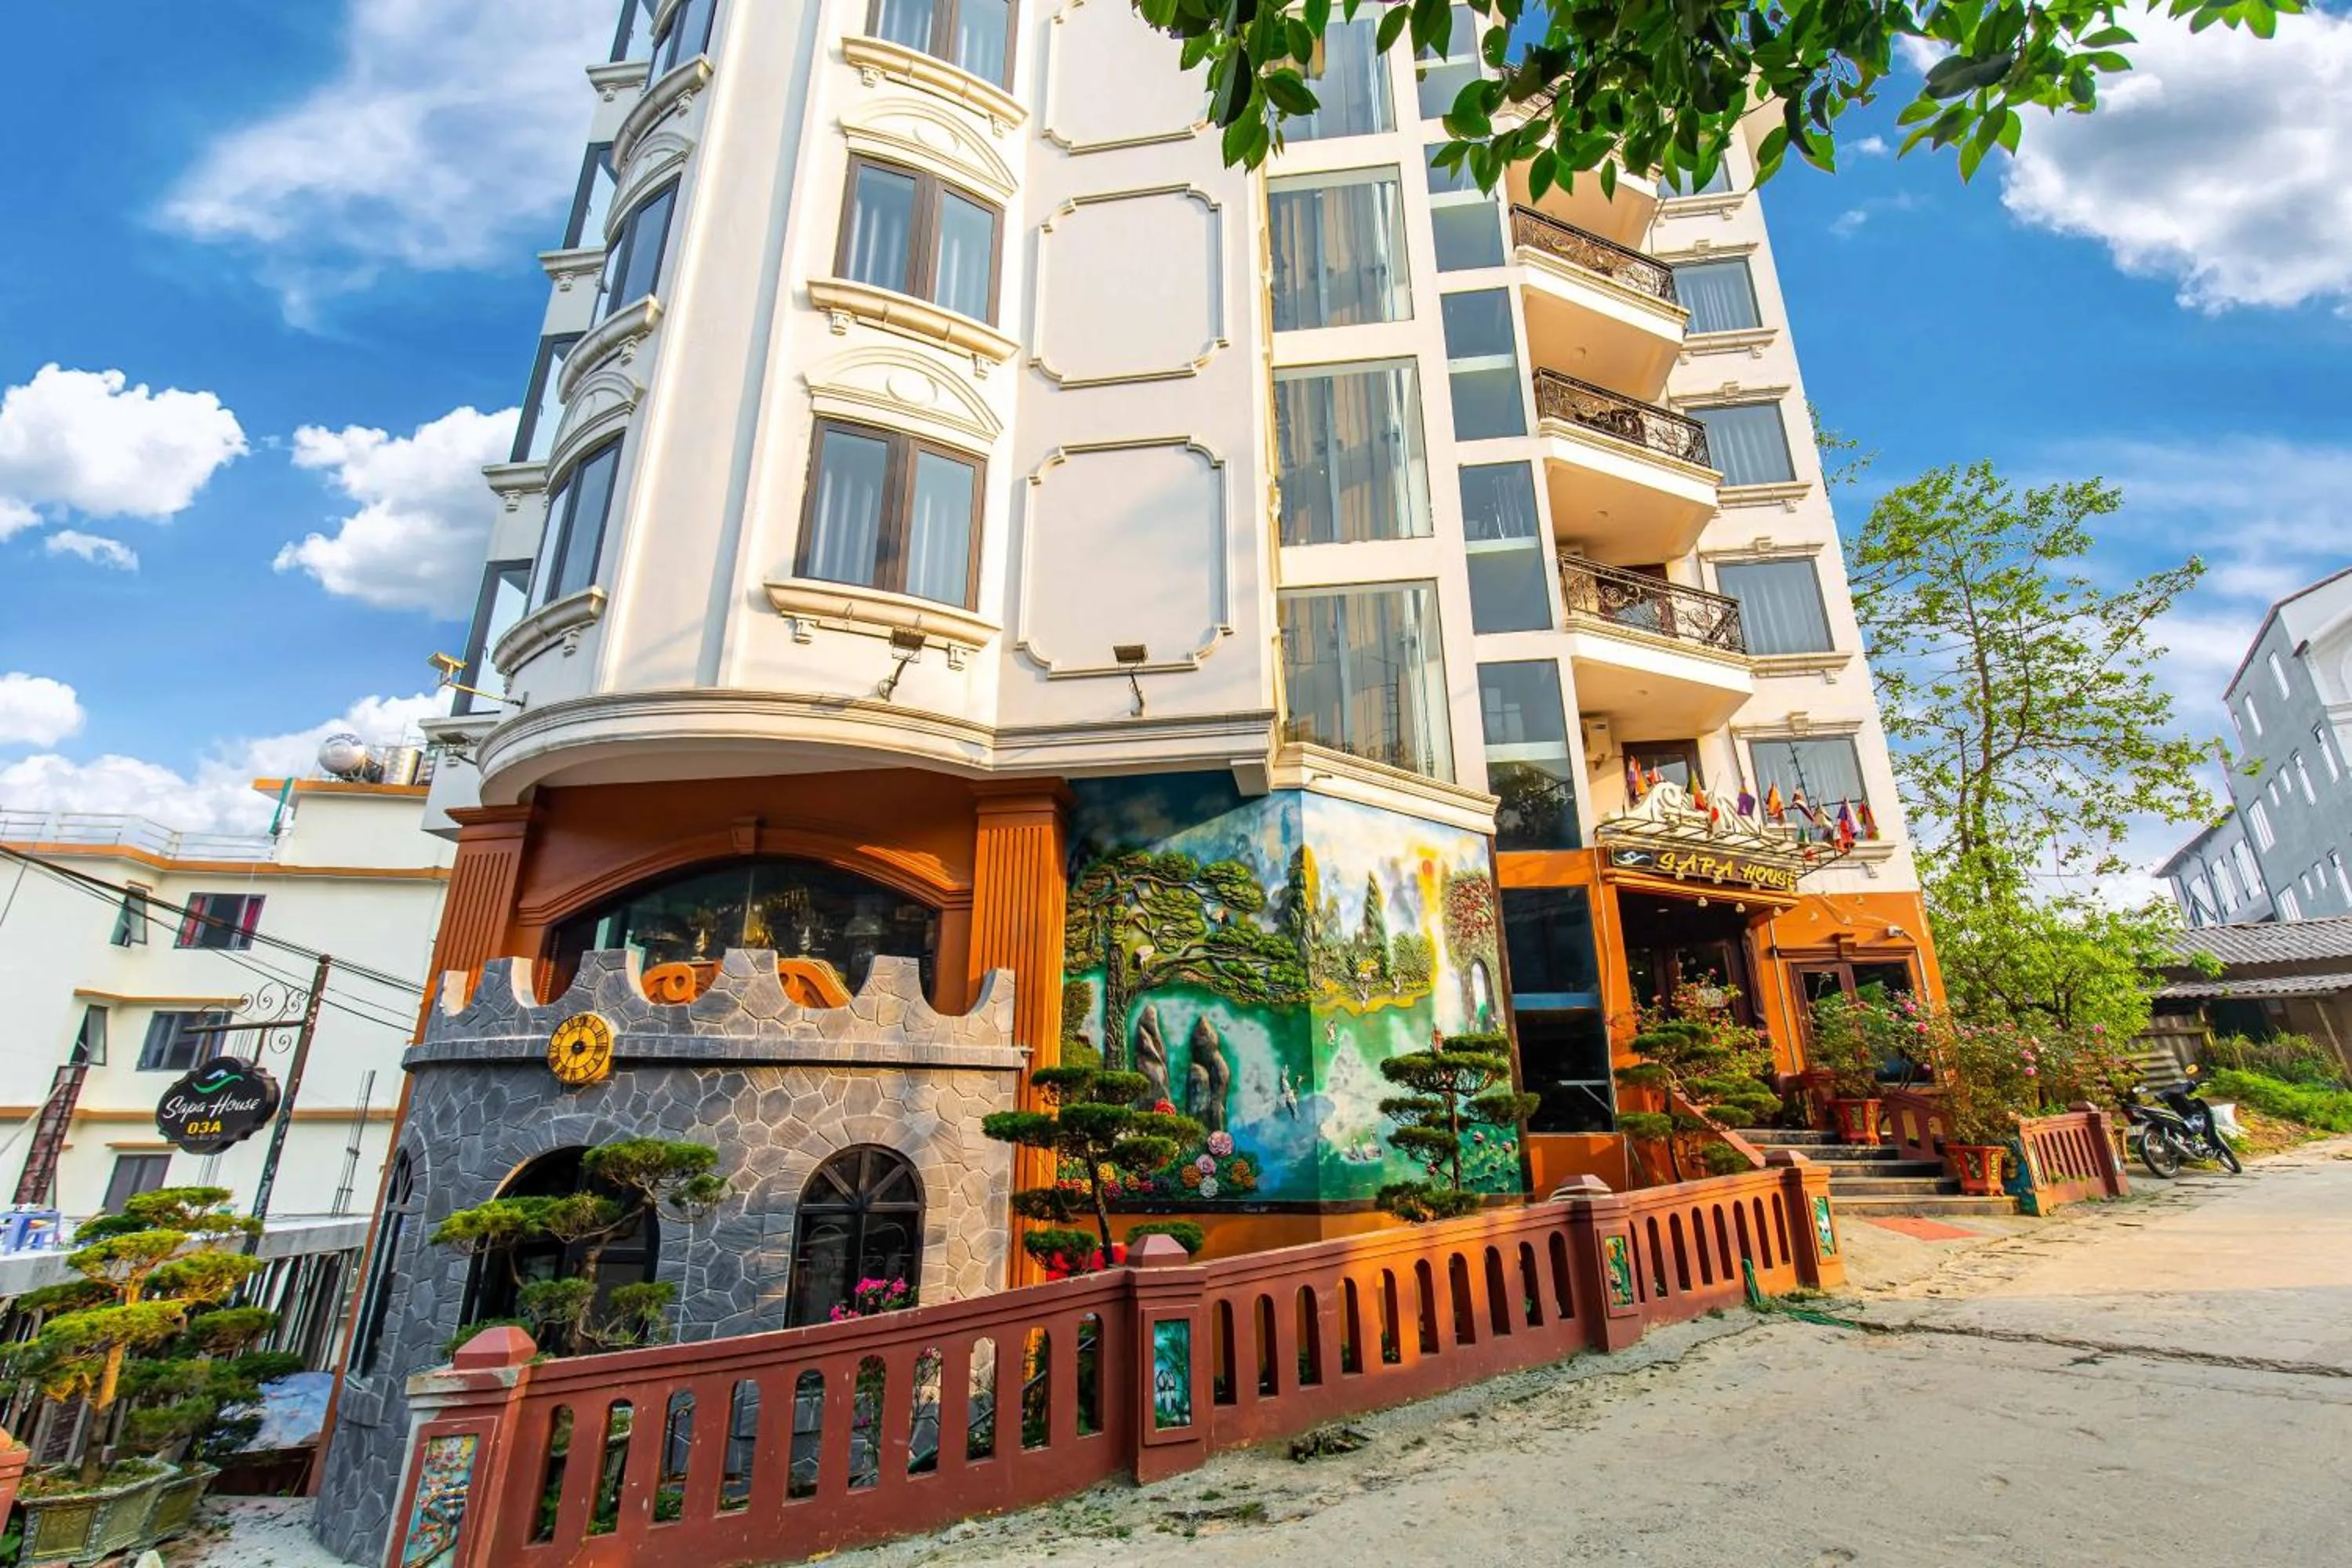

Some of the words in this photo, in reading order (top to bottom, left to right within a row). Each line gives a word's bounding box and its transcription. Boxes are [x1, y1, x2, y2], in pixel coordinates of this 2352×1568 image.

[1658, 852, 1733, 878] SAPA
[1741, 864, 1797, 889] HOUSE
[162, 1096, 205, 1123] Sapa
[209, 1092, 261, 1117] House
[187, 1121, 221, 1134] 03A
